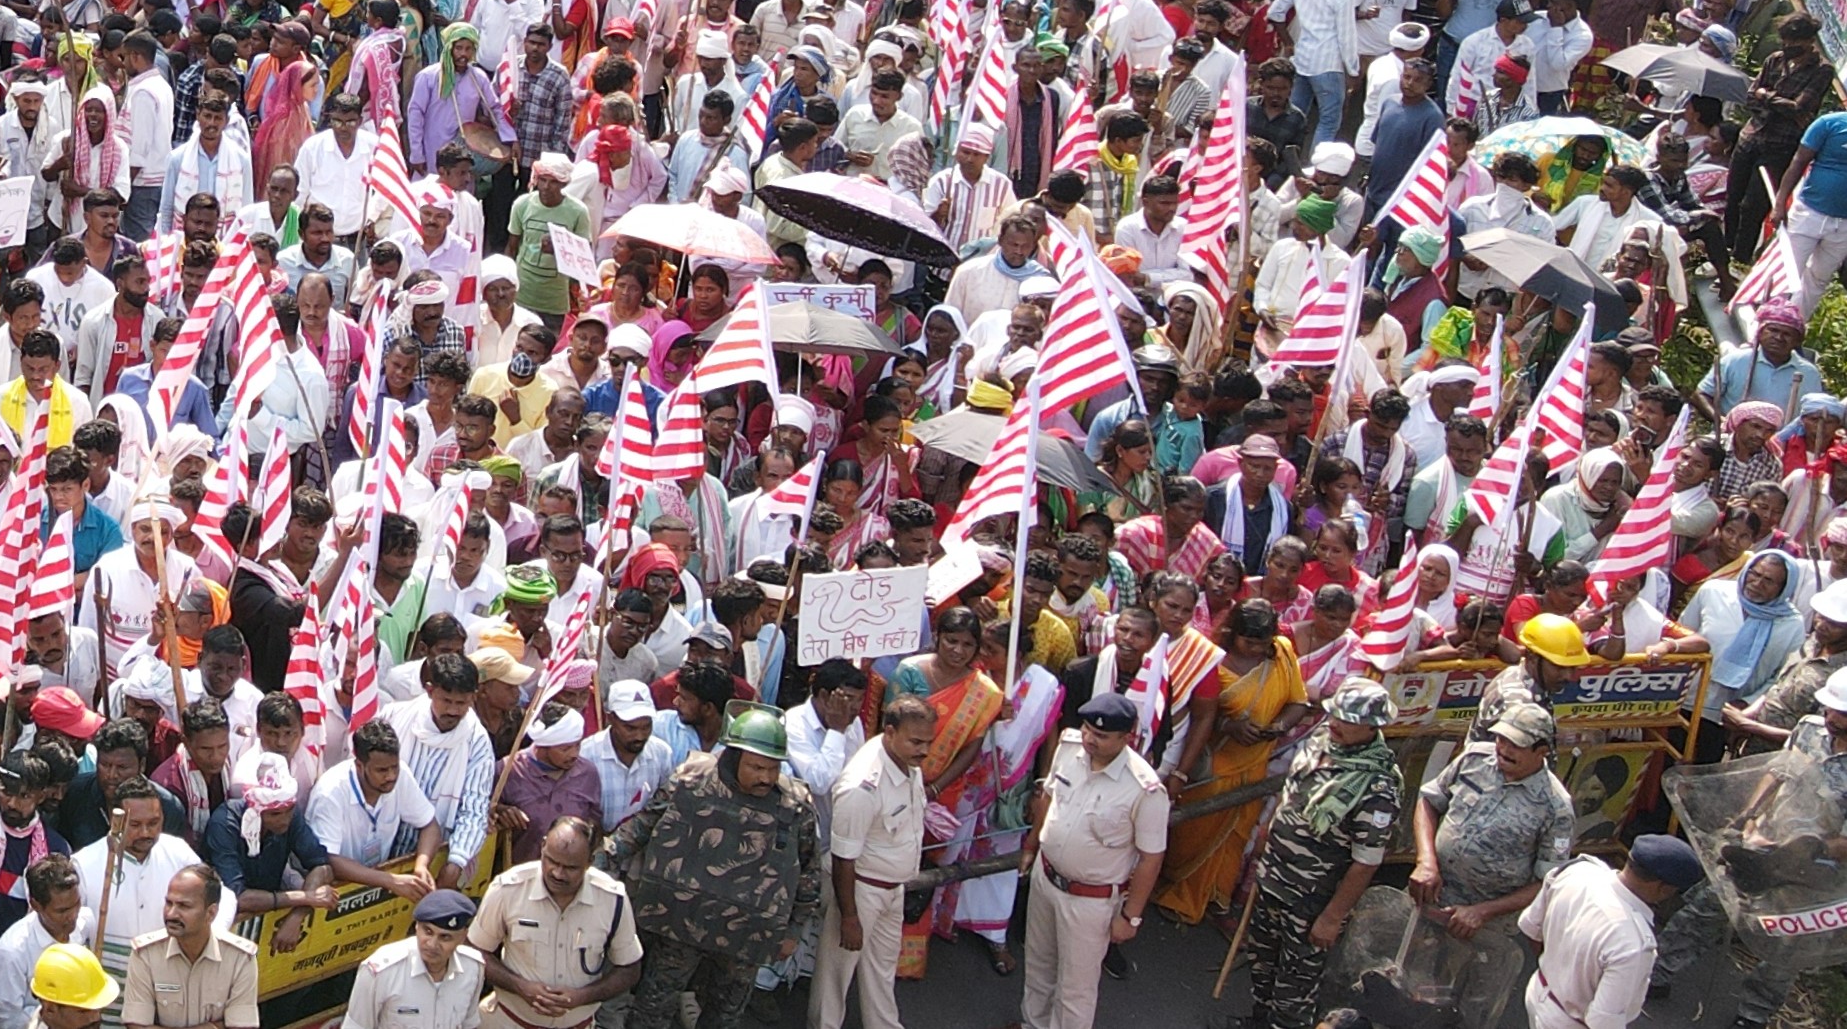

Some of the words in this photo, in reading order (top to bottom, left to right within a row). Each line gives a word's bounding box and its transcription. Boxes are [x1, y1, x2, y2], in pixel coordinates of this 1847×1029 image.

[1576, 667, 1688, 703] पुलिस
[346, 919, 367, 931] TMT
[369, 908, 400, 924] BARS
[1761, 905, 1847, 934] POLICE
